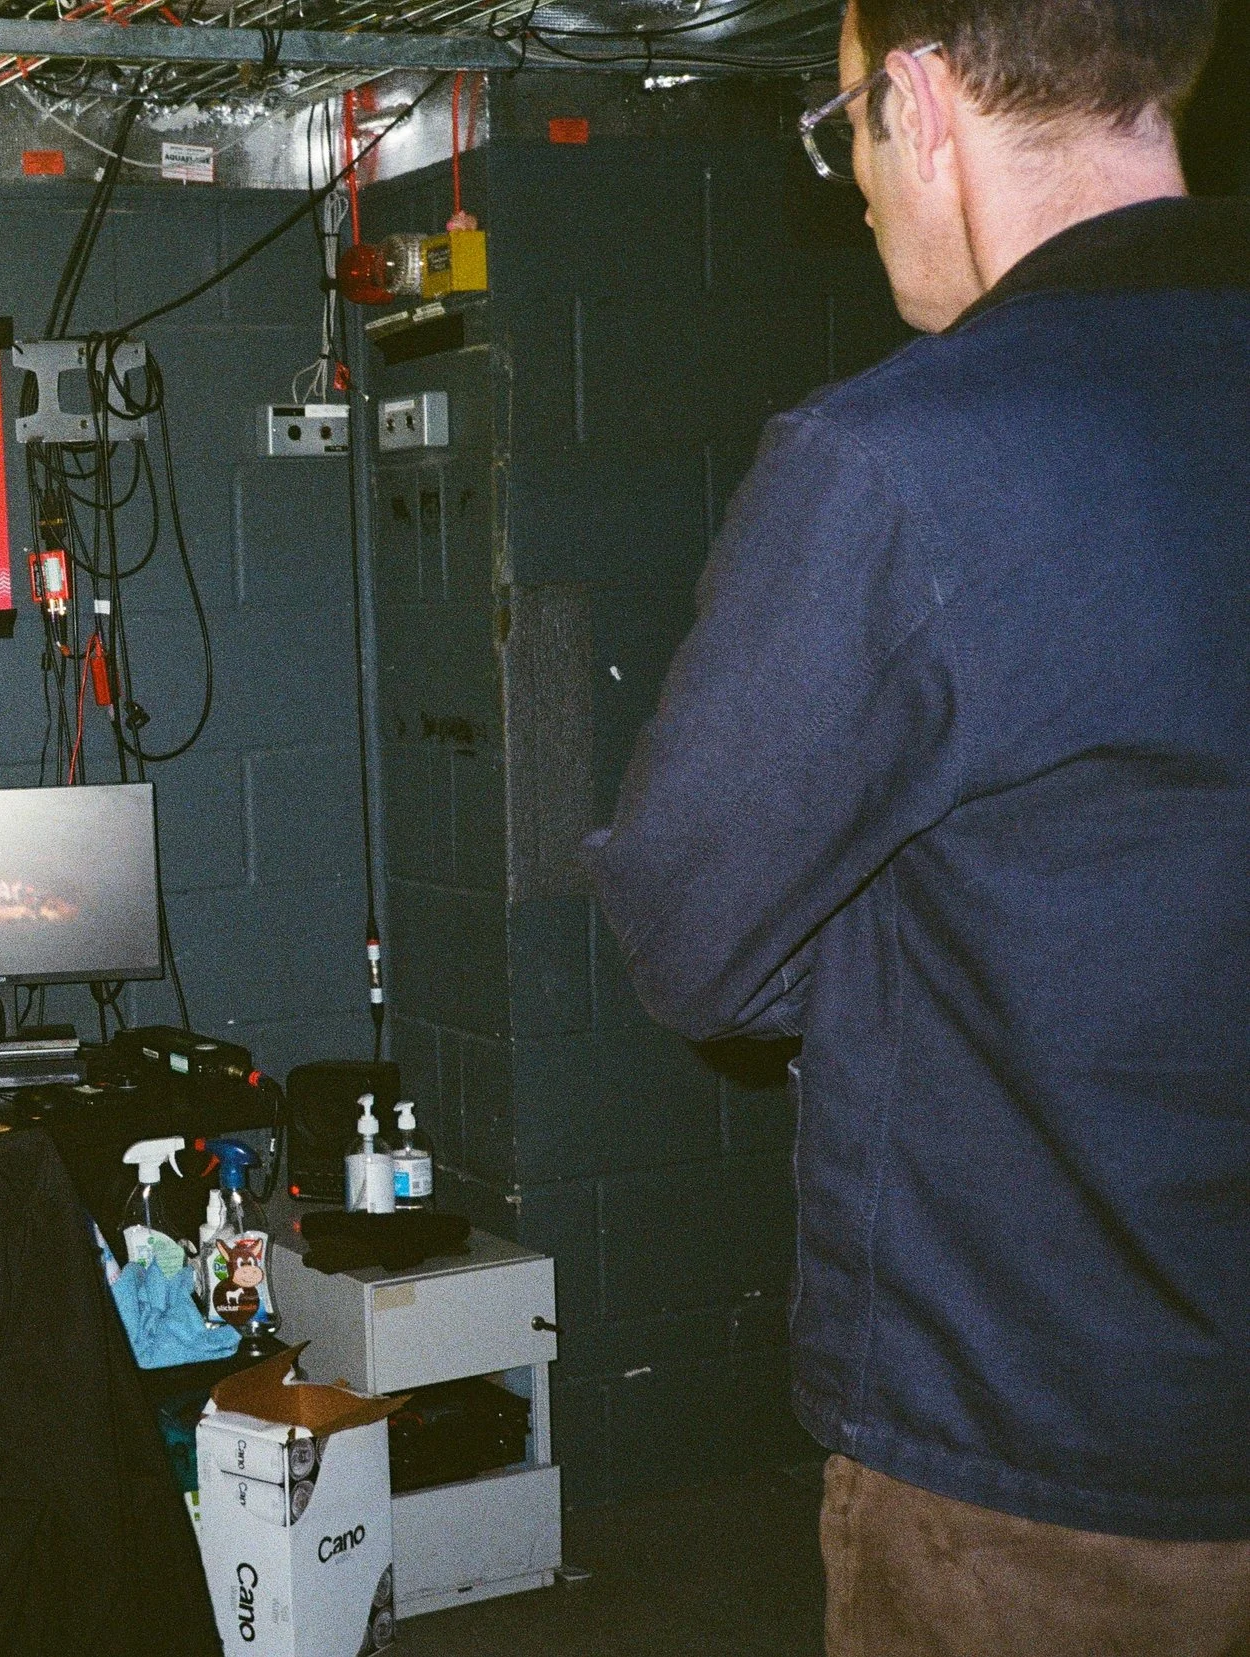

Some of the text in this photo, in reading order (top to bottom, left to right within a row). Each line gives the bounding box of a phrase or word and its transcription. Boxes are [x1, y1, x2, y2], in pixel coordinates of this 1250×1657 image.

[237, 1440, 247, 1470] Cano
[318, 1524, 365, 1563] Cano
[236, 1562, 258, 1642] Cano
